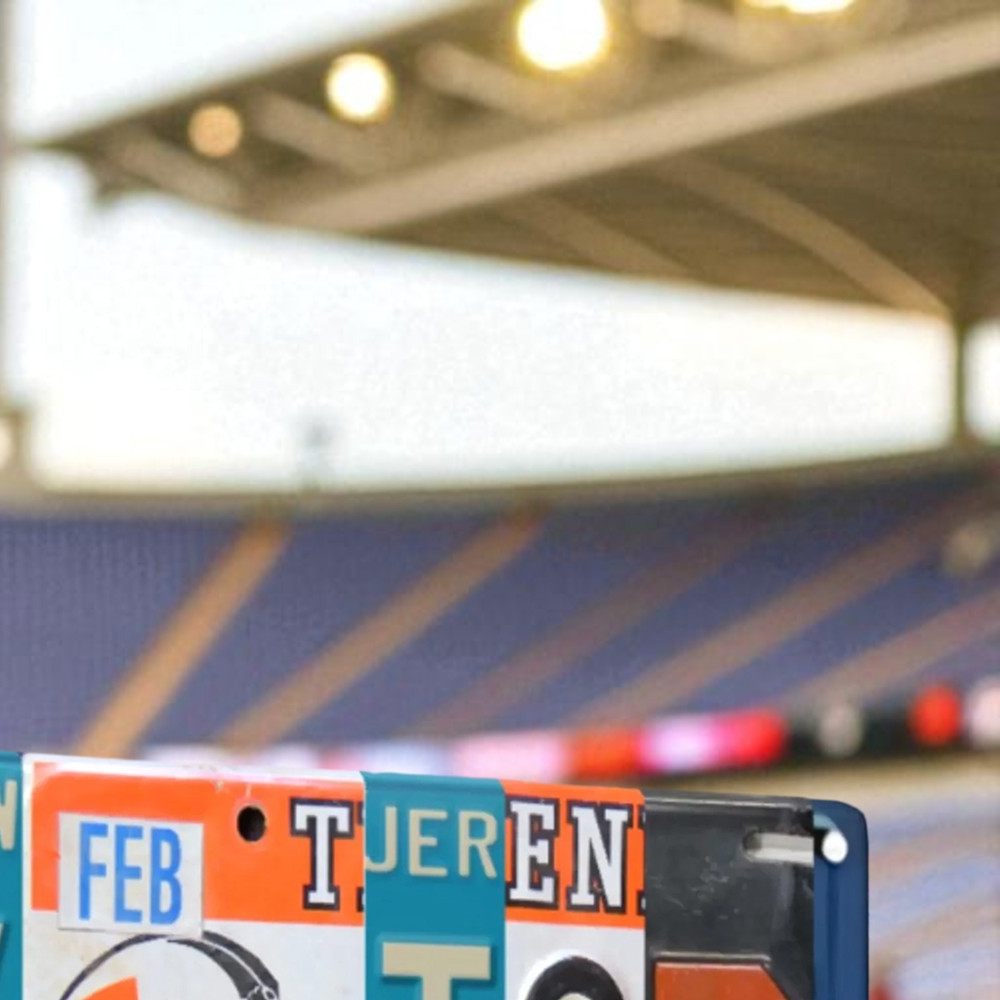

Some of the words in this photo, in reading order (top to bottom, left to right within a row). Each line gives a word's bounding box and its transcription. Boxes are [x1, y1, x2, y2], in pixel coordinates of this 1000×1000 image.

[78, 821, 183, 925] FEB
[290, 797, 364, 913] T
[365, 806, 498, 878] JER
[506, 795, 646, 916] EN
